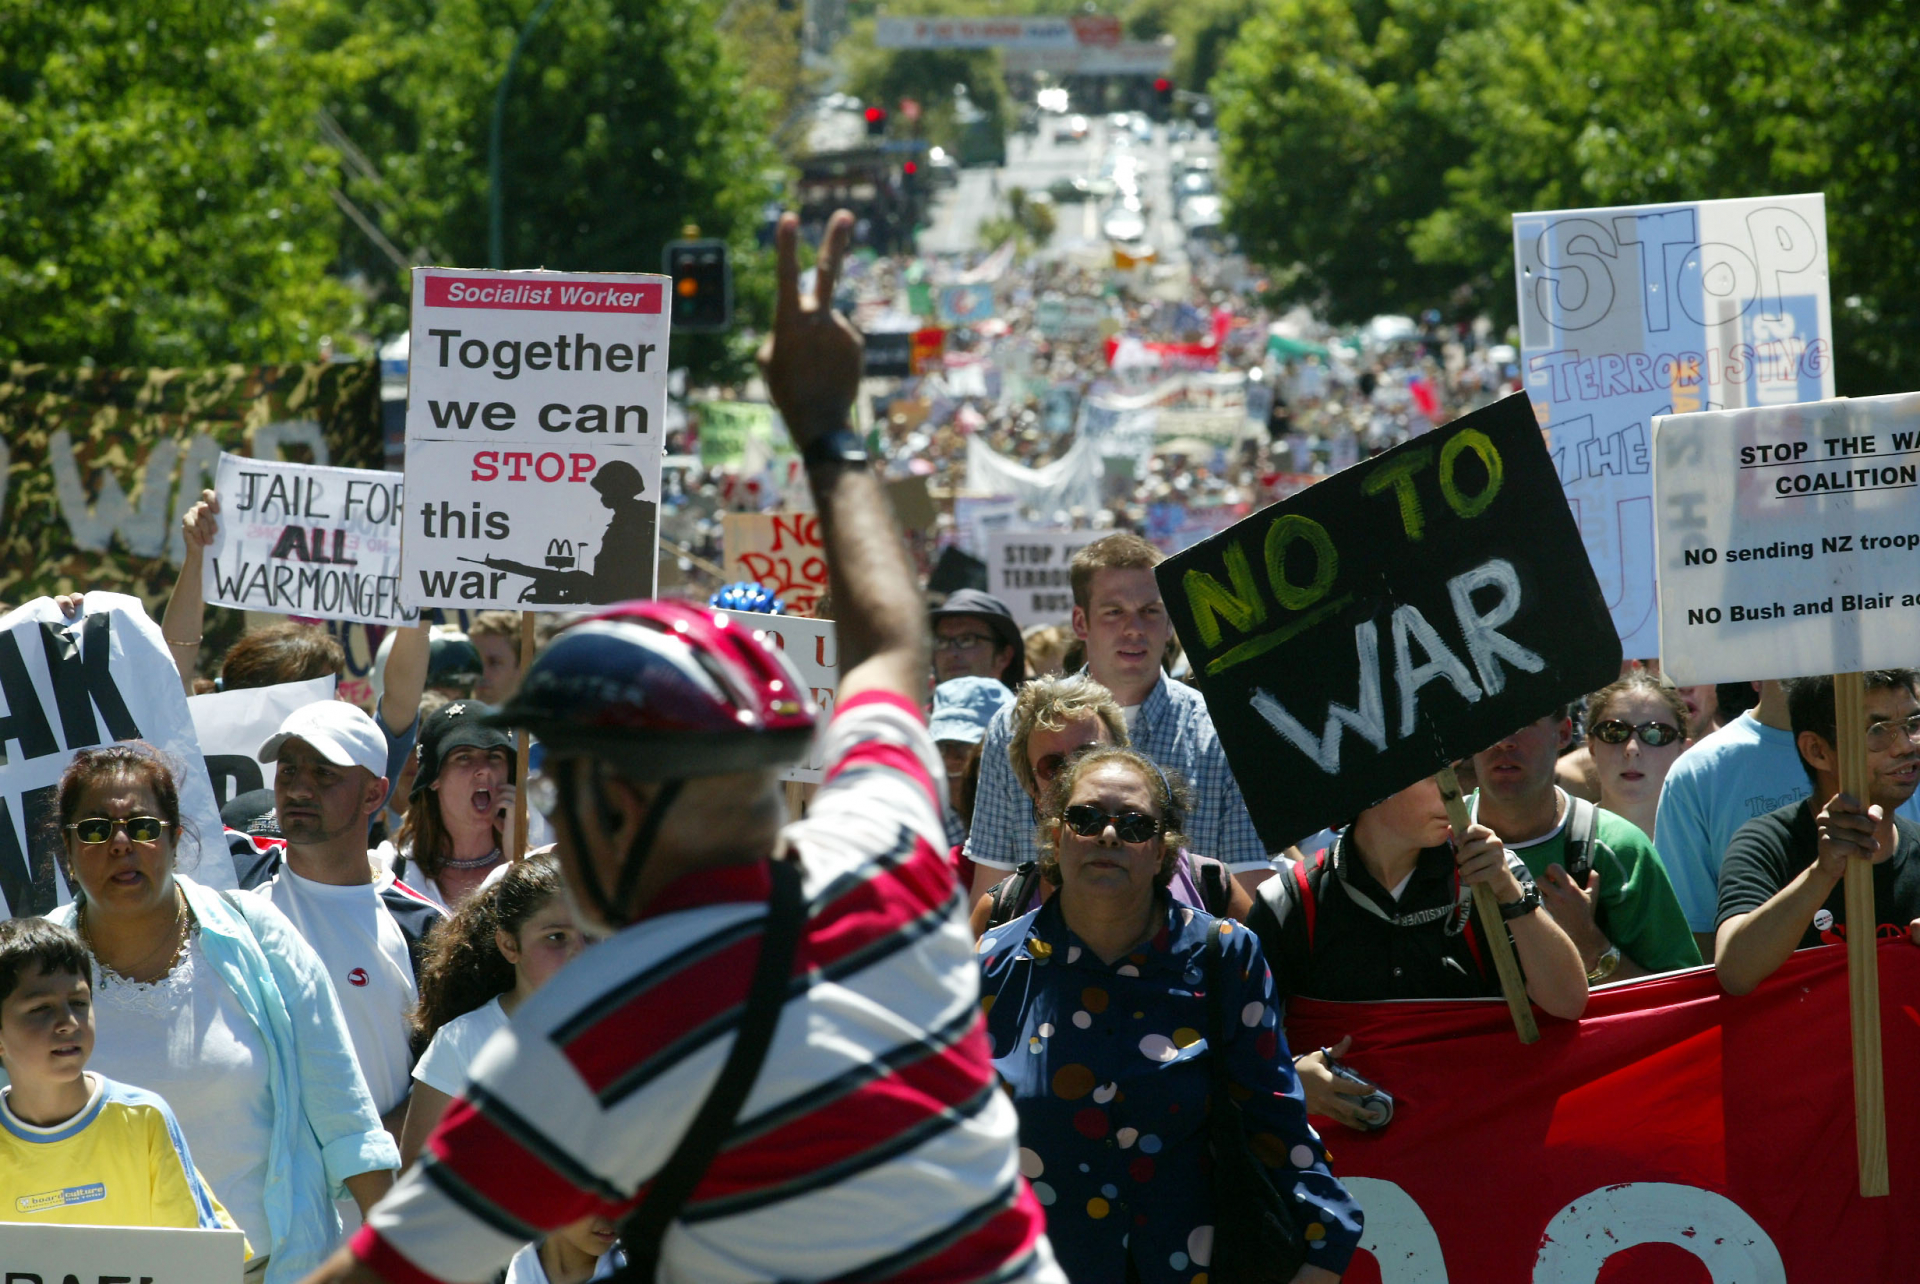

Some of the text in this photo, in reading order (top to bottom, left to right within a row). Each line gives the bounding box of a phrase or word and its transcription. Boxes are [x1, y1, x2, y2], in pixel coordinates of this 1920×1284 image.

[1536, 207, 1818, 332] STOP
[447, 282, 644, 307] Socialist Worker
[428, 329, 655, 380] Together
[1530, 338, 1830, 403] TERRORISING
[427, 400, 648, 434] we can
[471, 451, 597, 483] STOP
[1740, 442, 1808, 465] STOP
[1824, 435, 1876, 457] THE
[236, 472, 330, 519] JAIL
[1775, 464, 1917, 495] COALITION
[420, 501, 510, 540] this
[270, 525, 358, 565] ALL
[1004, 545, 1053, 563] STOP
[1183, 514, 1338, 649] NO
[1361, 427, 1503, 541] TO
[1684, 547, 1718, 566] NO
[1725, 541, 1814, 563] sending
[1822, 535, 1853, 554] NZ
[419, 569, 507, 600] war
[1687, 607, 1722, 626] NO
[1730, 602, 1786, 622] Bush
[1793, 597, 1833, 616] and
[1841, 592, 1894, 612] Blair
[1249, 557, 1546, 776] WAR
